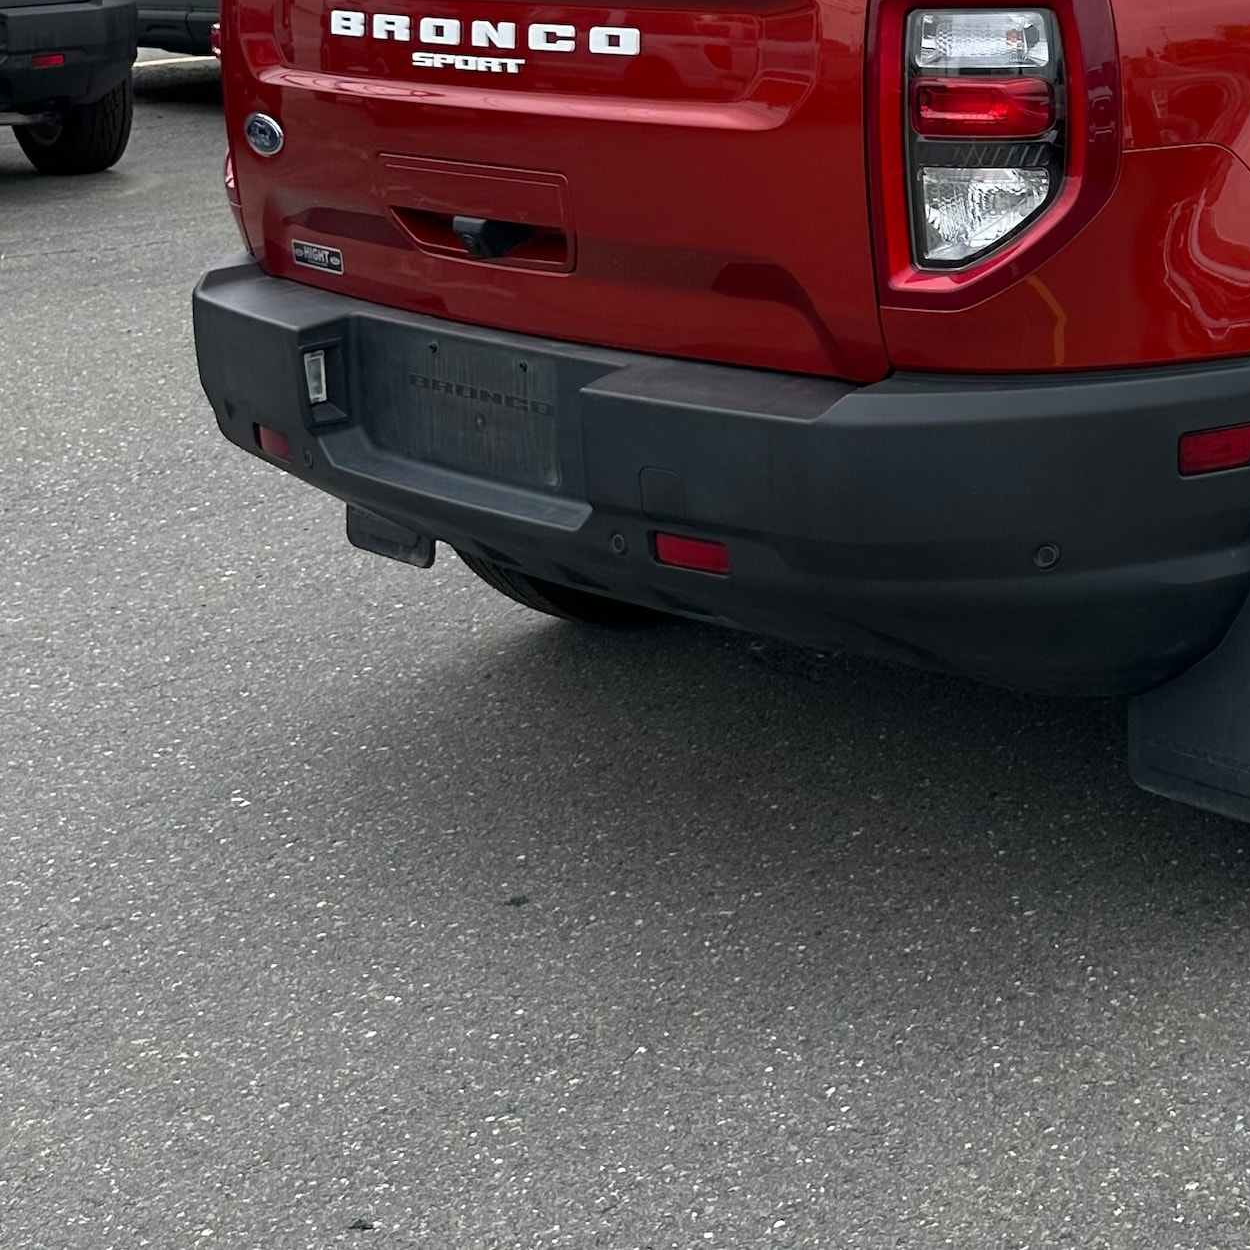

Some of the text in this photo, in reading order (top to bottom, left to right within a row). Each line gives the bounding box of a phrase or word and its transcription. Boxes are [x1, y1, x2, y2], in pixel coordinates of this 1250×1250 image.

[330, 9, 642, 57] BRONCO
[411, 51, 526, 74] SPORT
[407, 371, 556, 417] BRONCO
